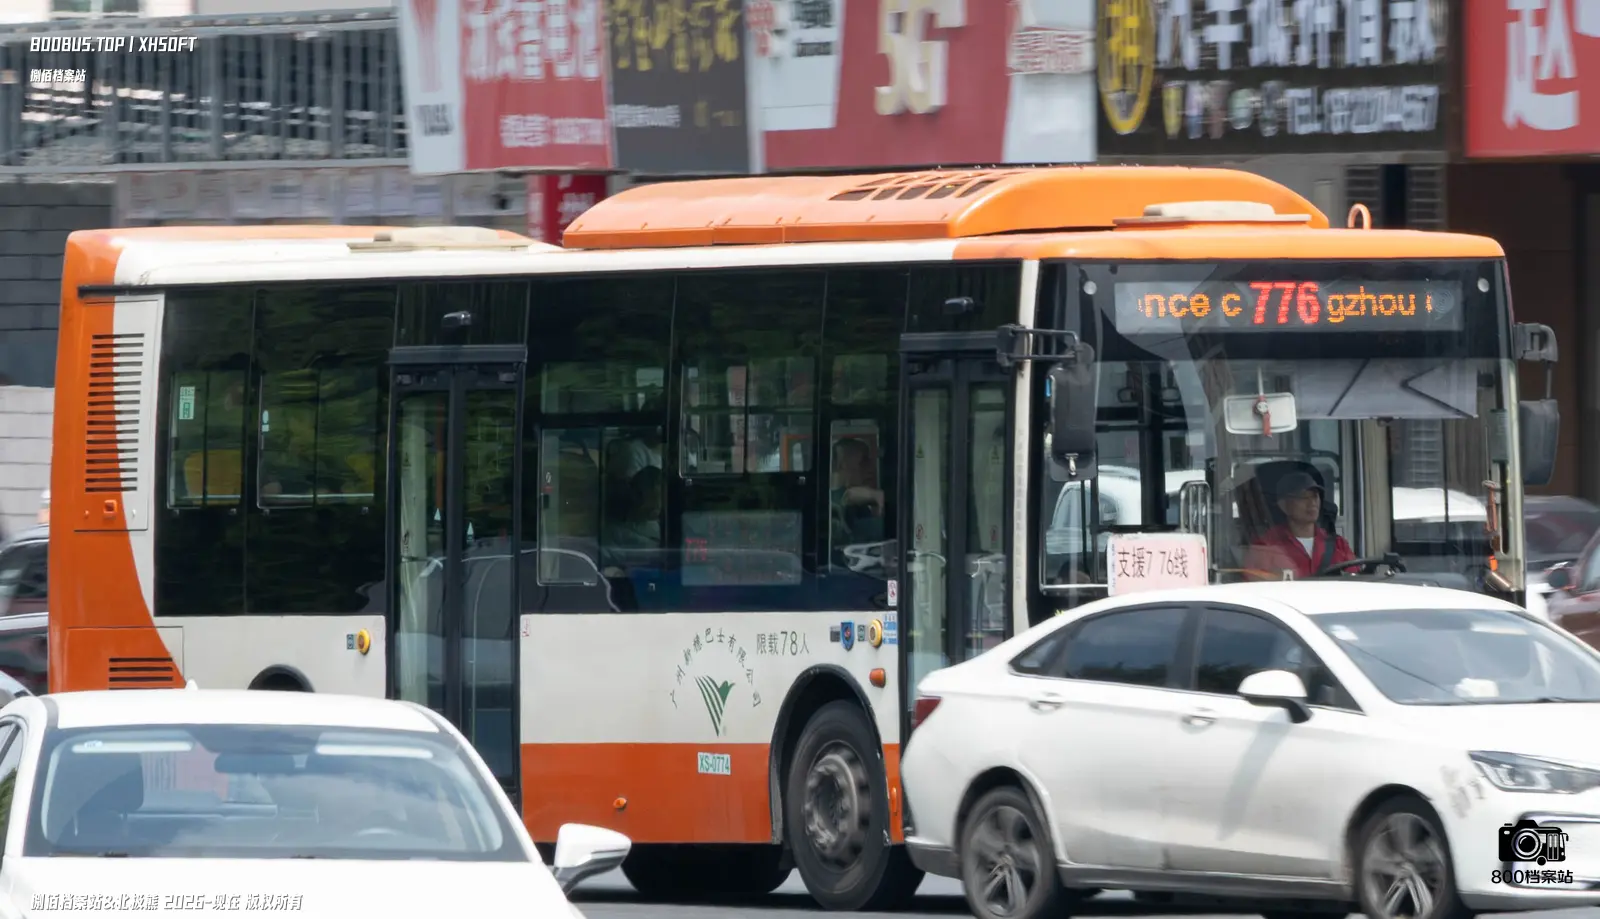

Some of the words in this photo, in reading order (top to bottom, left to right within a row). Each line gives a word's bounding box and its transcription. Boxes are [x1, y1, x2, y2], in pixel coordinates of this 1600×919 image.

[1250, 282, 1320, 324] 776
[1327, 286, 1416, 323] gzhou
[756, 630, 810, 656] 限载78人
[699, 754, 730, 773] XS-0774
